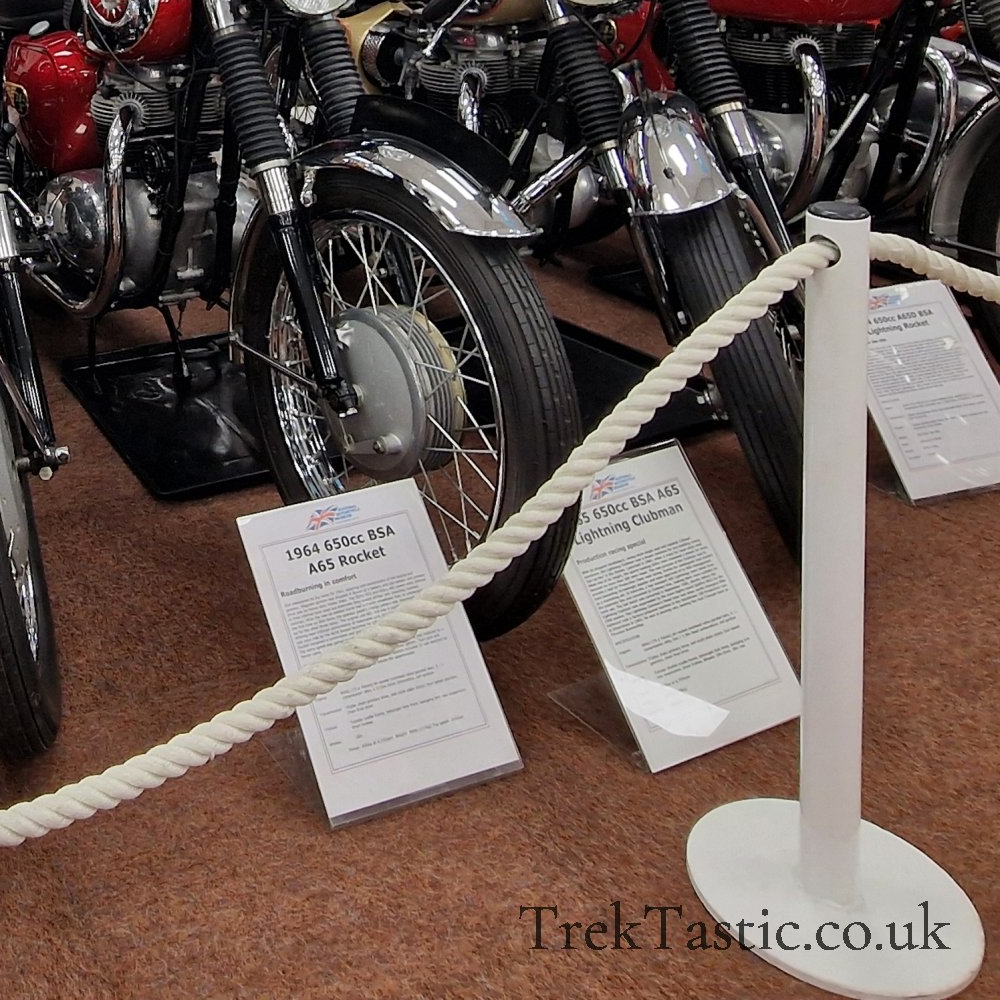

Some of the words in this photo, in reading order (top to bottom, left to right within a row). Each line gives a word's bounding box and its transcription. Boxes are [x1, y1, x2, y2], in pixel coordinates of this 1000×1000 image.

[592, 502, 630, 520] 650cc
[629, 492, 655, 508] BSA
[657, 483, 680, 500] A65
[631, 503, 684, 526] Clubman
[285, 543, 320, 561] 1964
[324, 534, 365, 551] 650cc
[367, 525, 395, 541] BSA
[309, 558, 335, 575] A65
[338, 545, 386, 567] Rocket
[280, 582, 323, 598] Roadburning
[324, 579, 331, 587] in
